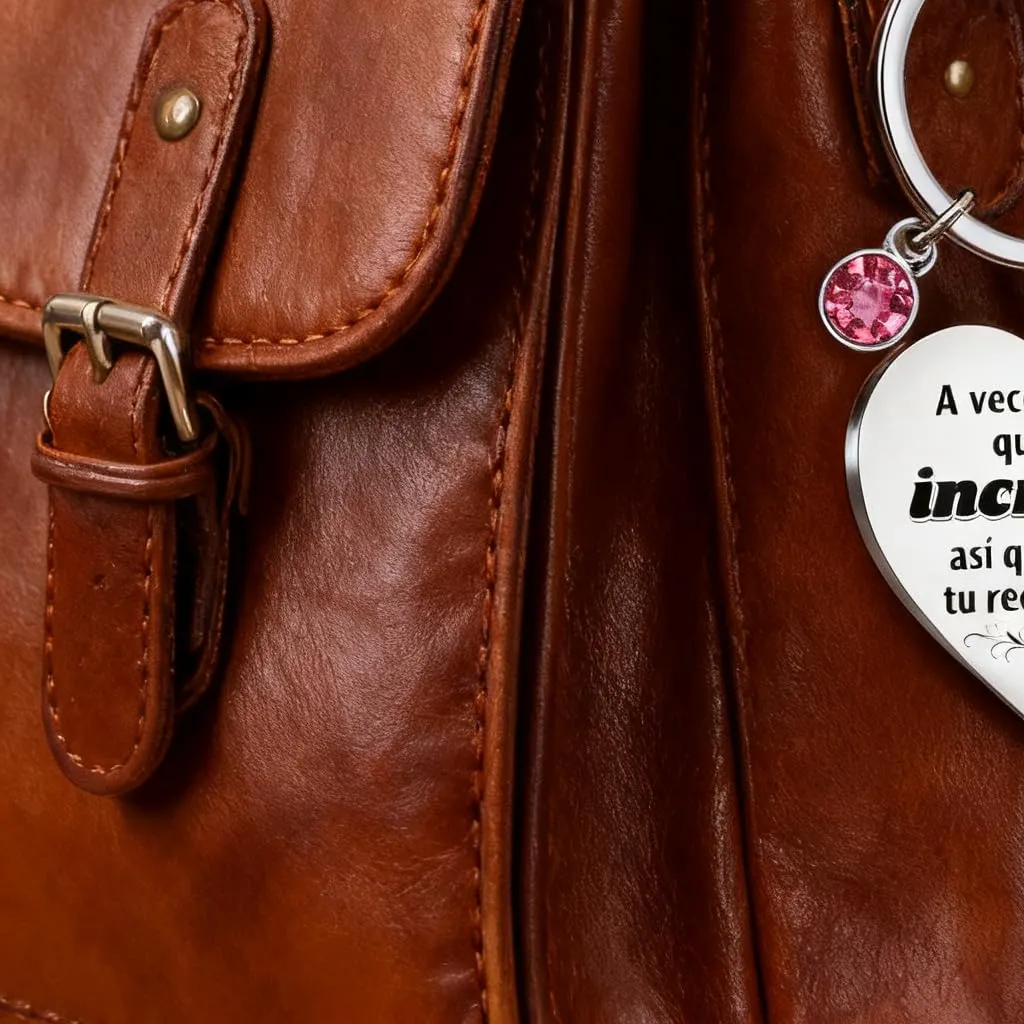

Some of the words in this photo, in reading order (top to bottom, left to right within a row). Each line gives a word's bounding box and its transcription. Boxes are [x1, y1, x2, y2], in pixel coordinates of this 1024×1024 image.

[935, 384, 959, 416] A
[950, 536, 993, 571] así
[943, 586, 976, 615] tu
